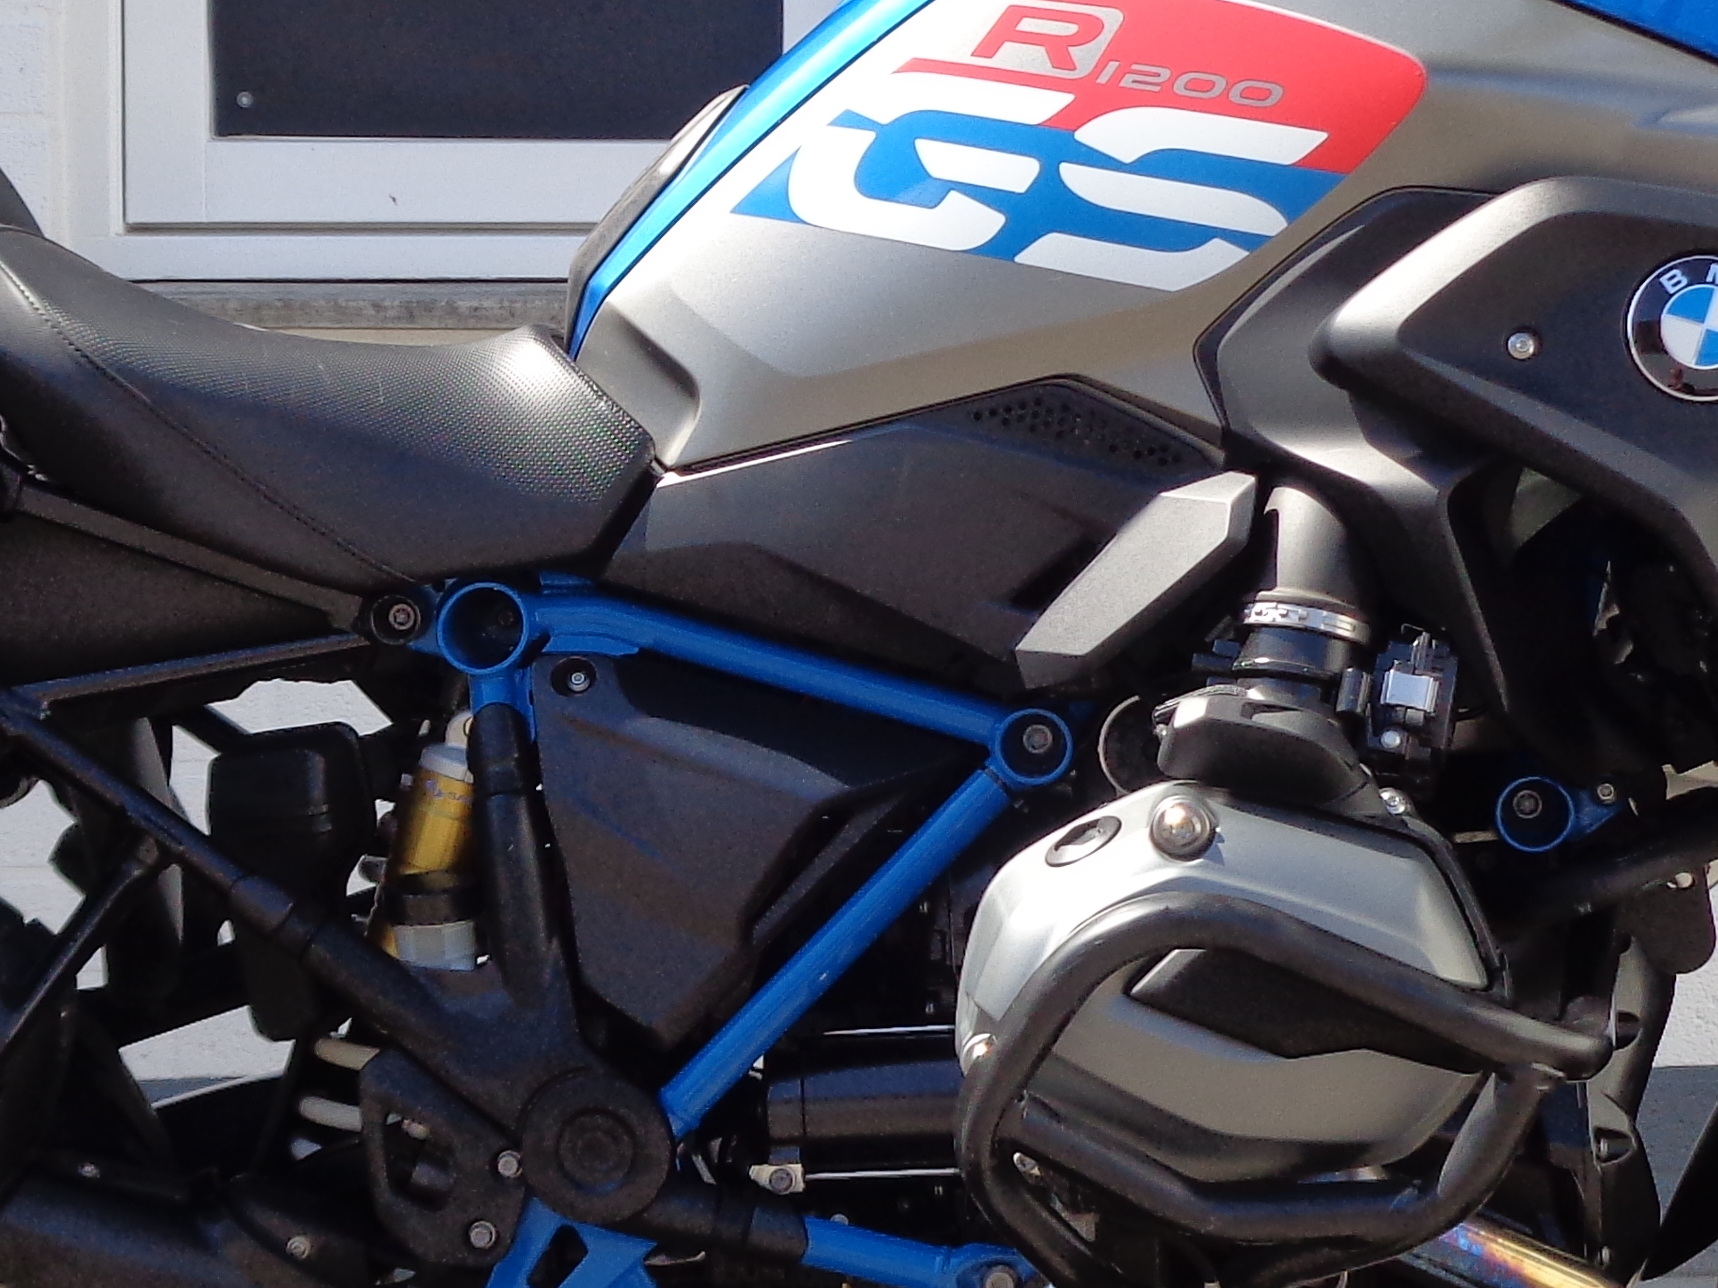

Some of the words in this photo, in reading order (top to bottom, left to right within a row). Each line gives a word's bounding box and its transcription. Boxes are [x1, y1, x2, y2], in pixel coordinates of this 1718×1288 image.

[970, 4, 1106, 72] R
[1095, 59, 1284, 108] 1200
[787, 71, 1329, 292] GS
